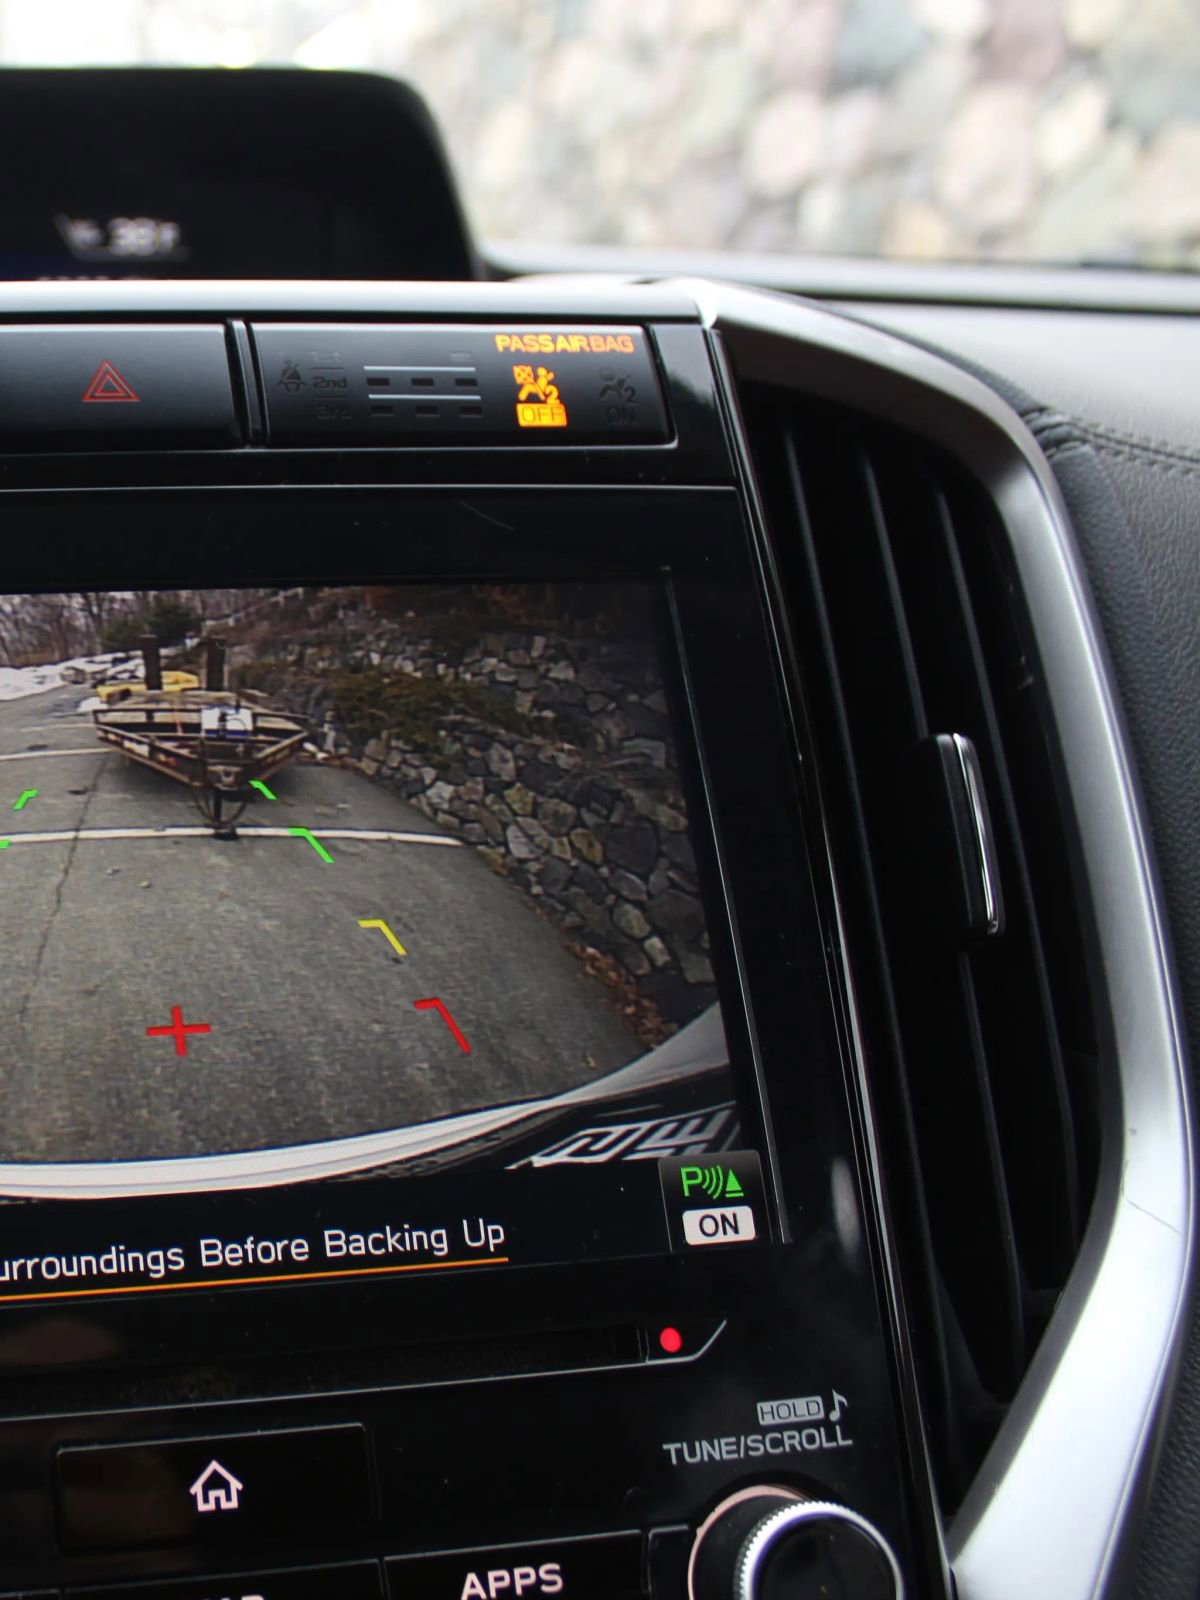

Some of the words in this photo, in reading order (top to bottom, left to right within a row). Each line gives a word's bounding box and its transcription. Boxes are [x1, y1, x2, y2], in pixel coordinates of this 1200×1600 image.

[494, 334, 555, 353] PASS
[312, 376, 348, 389] 2nd
[521, 406, 563, 423] OFF
[698, 1212, 740, 1237] ON
[199, 1236, 309, 1267] Before
[323, 1224, 449, 1258] Backing
[462, 1218, 505, 1252] Up
[759, 1399, 822, 1422] HOLD
[662, 1424, 854, 1466] TUNE/SCROLL
[460, 1562, 564, 1600] APPS
